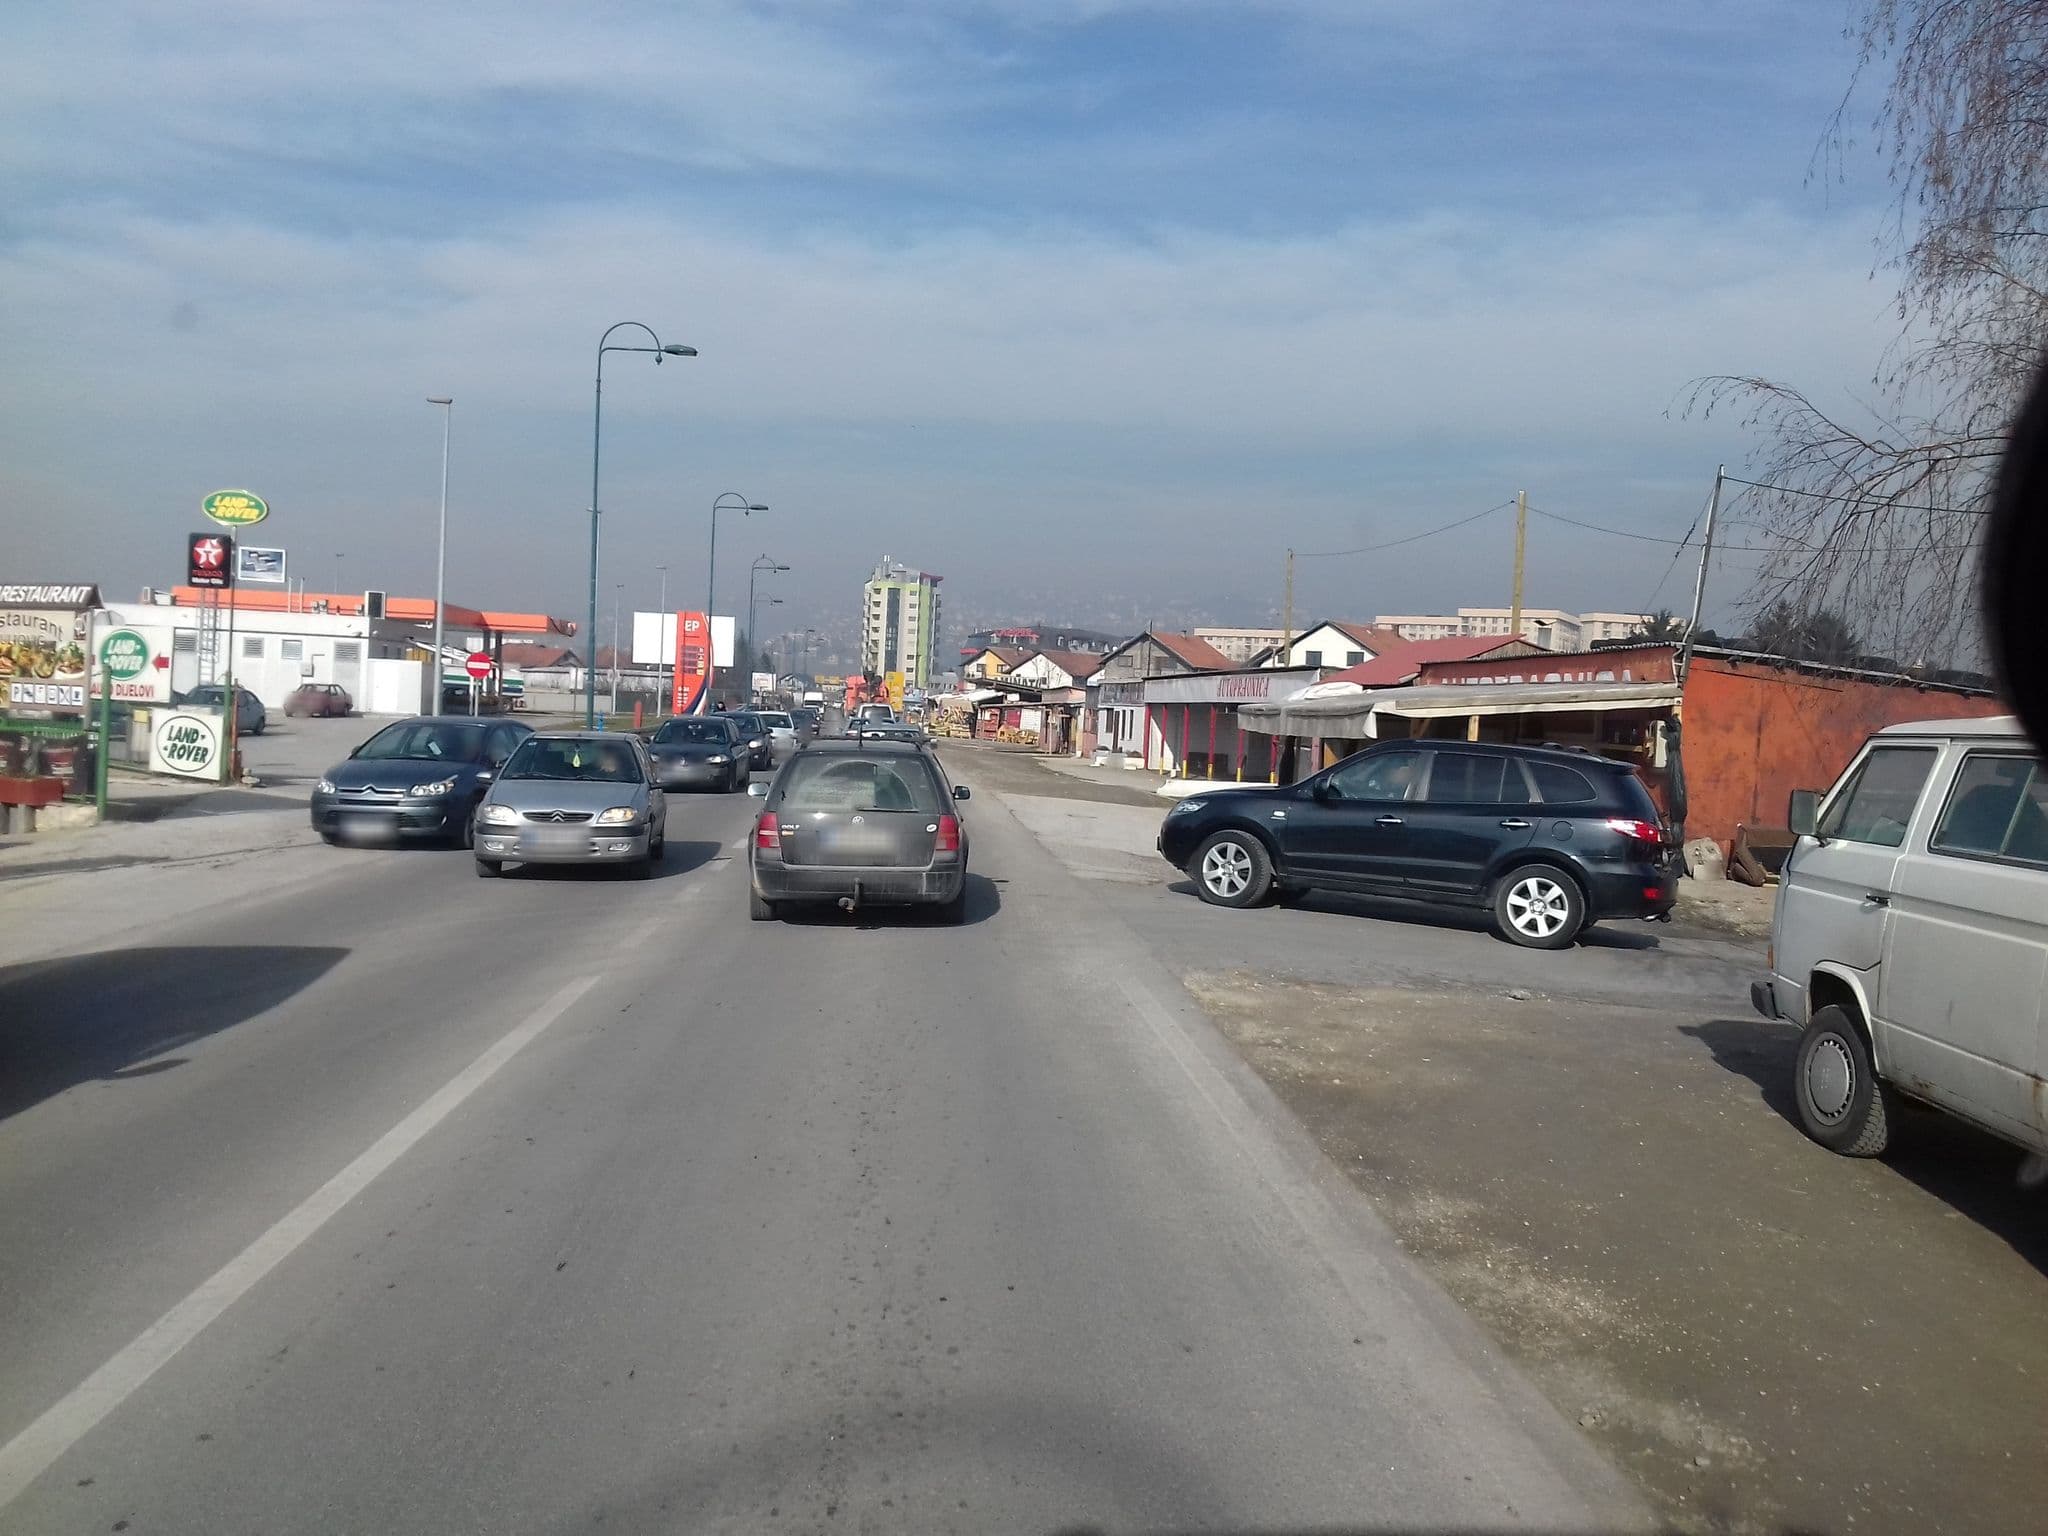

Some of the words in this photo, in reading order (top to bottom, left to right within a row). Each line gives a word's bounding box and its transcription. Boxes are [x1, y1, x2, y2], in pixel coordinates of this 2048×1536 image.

[213, 496, 248, 508] LAND
[215, 506, 260, 520] ROVER
[0, 585, 91, 603] RESTAURANT
[685, 620, 700, 632] EP
[107, 639, 136, 655] LAND
[108, 655, 144, 671] ROVER
[89, 682, 113, 696] AUO
[116, 683, 154, 697] DIJELOVI
[167, 725, 200, 744] LAND
[168, 744, 209, 764] ROVER
